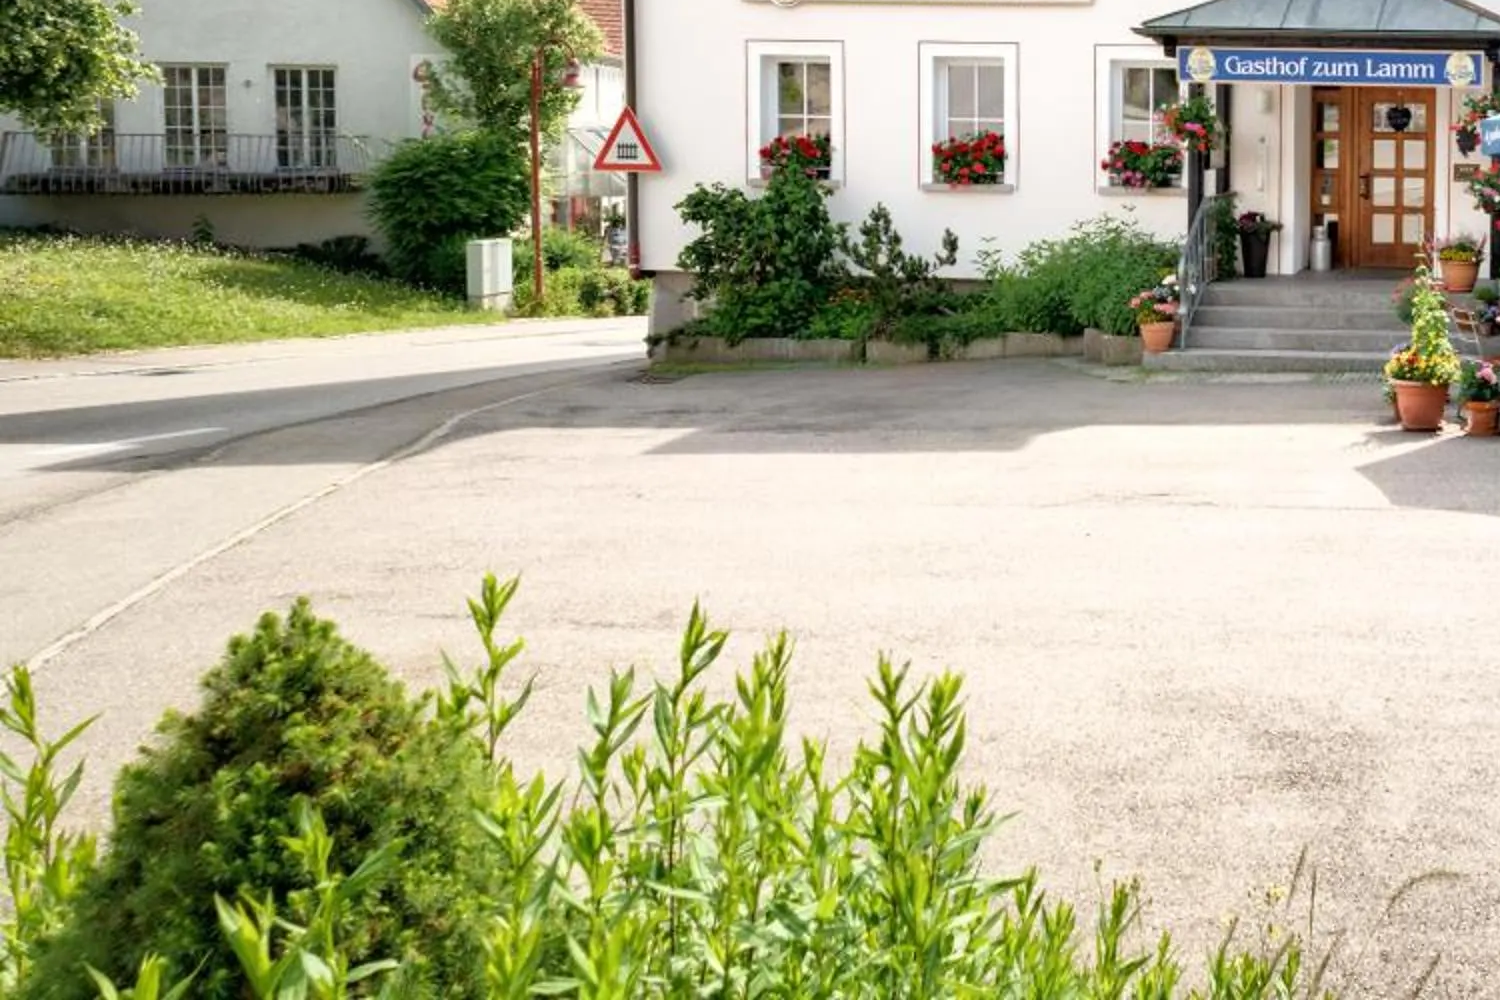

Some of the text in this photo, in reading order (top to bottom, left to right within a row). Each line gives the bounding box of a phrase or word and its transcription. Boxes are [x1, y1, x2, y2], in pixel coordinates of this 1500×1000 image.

[1224, 55, 1435, 79] Gasthof zum Lamm
